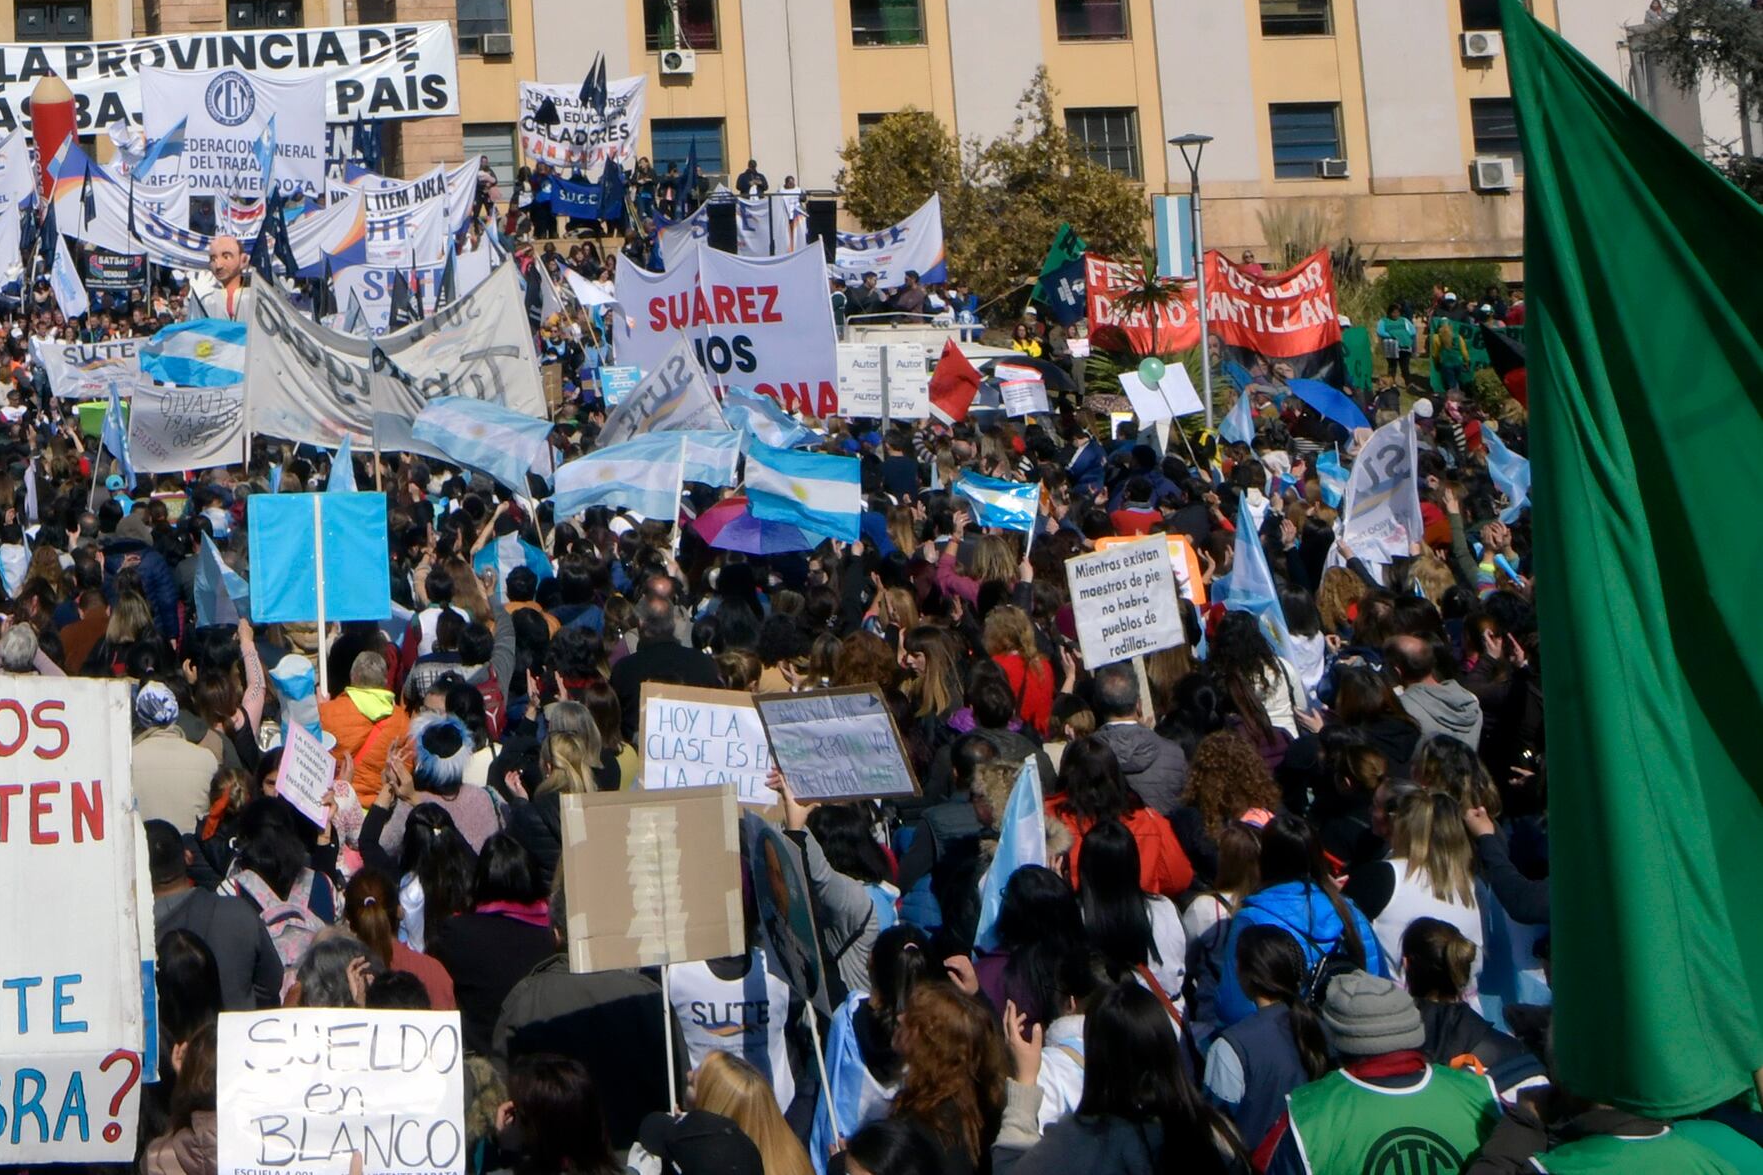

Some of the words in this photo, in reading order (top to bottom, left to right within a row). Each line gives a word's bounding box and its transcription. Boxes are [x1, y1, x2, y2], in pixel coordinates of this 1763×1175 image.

[65, 31, 350, 80] PROVINCIA
[359, 27, 420, 66] DE
[335, 60, 448, 115] PAÍS
[521, 115, 630, 145] CELADORES
[189, 155, 215, 169] DEL
[217, 156, 262, 172] TRABA
[375, 191, 410, 211] ITEM
[414, 173, 446, 203] AULA
[648, 273, 783, 332] SUÁREZ
[62, 342, 136, 366] SUTE
[1075, 558, 1122, 579] Mientras
[1123, 549, 1160, 568] existan
[1079, 579, 1128, 600] maestros
[1129, 572, 1142, 588] de
[1145, 568, 1161, 589] pie
[1101, 603, 1116, 616] no
[1101, 615, 1142, 642] pueblos
[1144, 610, 1157, 624] de
[1109, 636, 1157, 658] rodillas...
[659, 705, 701, 734] HOY
[710, 711, 741, 739] LA
[646, 734, 713, 765] CLASE
[726, 740, 749, 769] ES
[662, 765, 688, 789] LA
[691, 999, 770, 1026] SUTE
[244, 1018, 459, 1074] SUELDO
[304, 1083, 365, 1116] en
[250, 1113, 461, 1168] BLANCO
